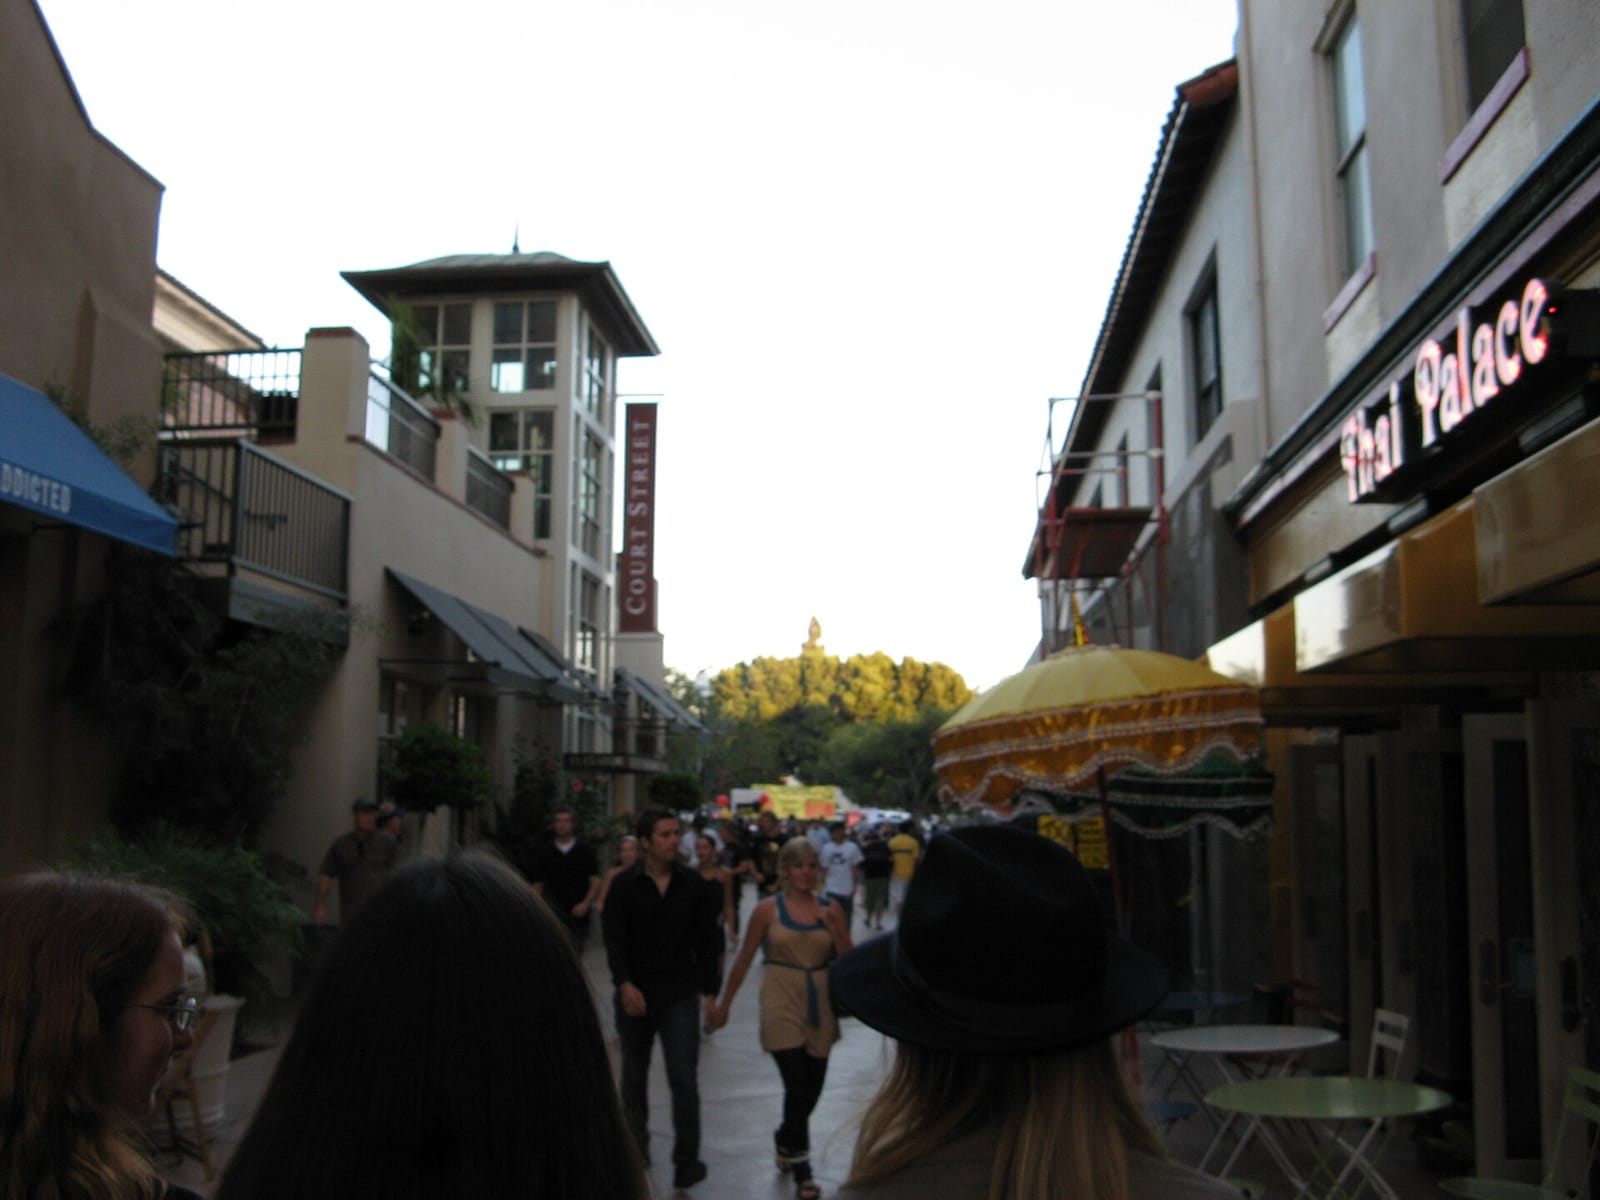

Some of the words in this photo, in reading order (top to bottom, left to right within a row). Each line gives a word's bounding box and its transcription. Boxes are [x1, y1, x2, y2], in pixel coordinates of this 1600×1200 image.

[1340, 382, 1403, 503] Thai
[1414, 278, 1549, 448] Palace
[627, 420, 650, 516] STREET
[626, 527, 648, 615] COURT
